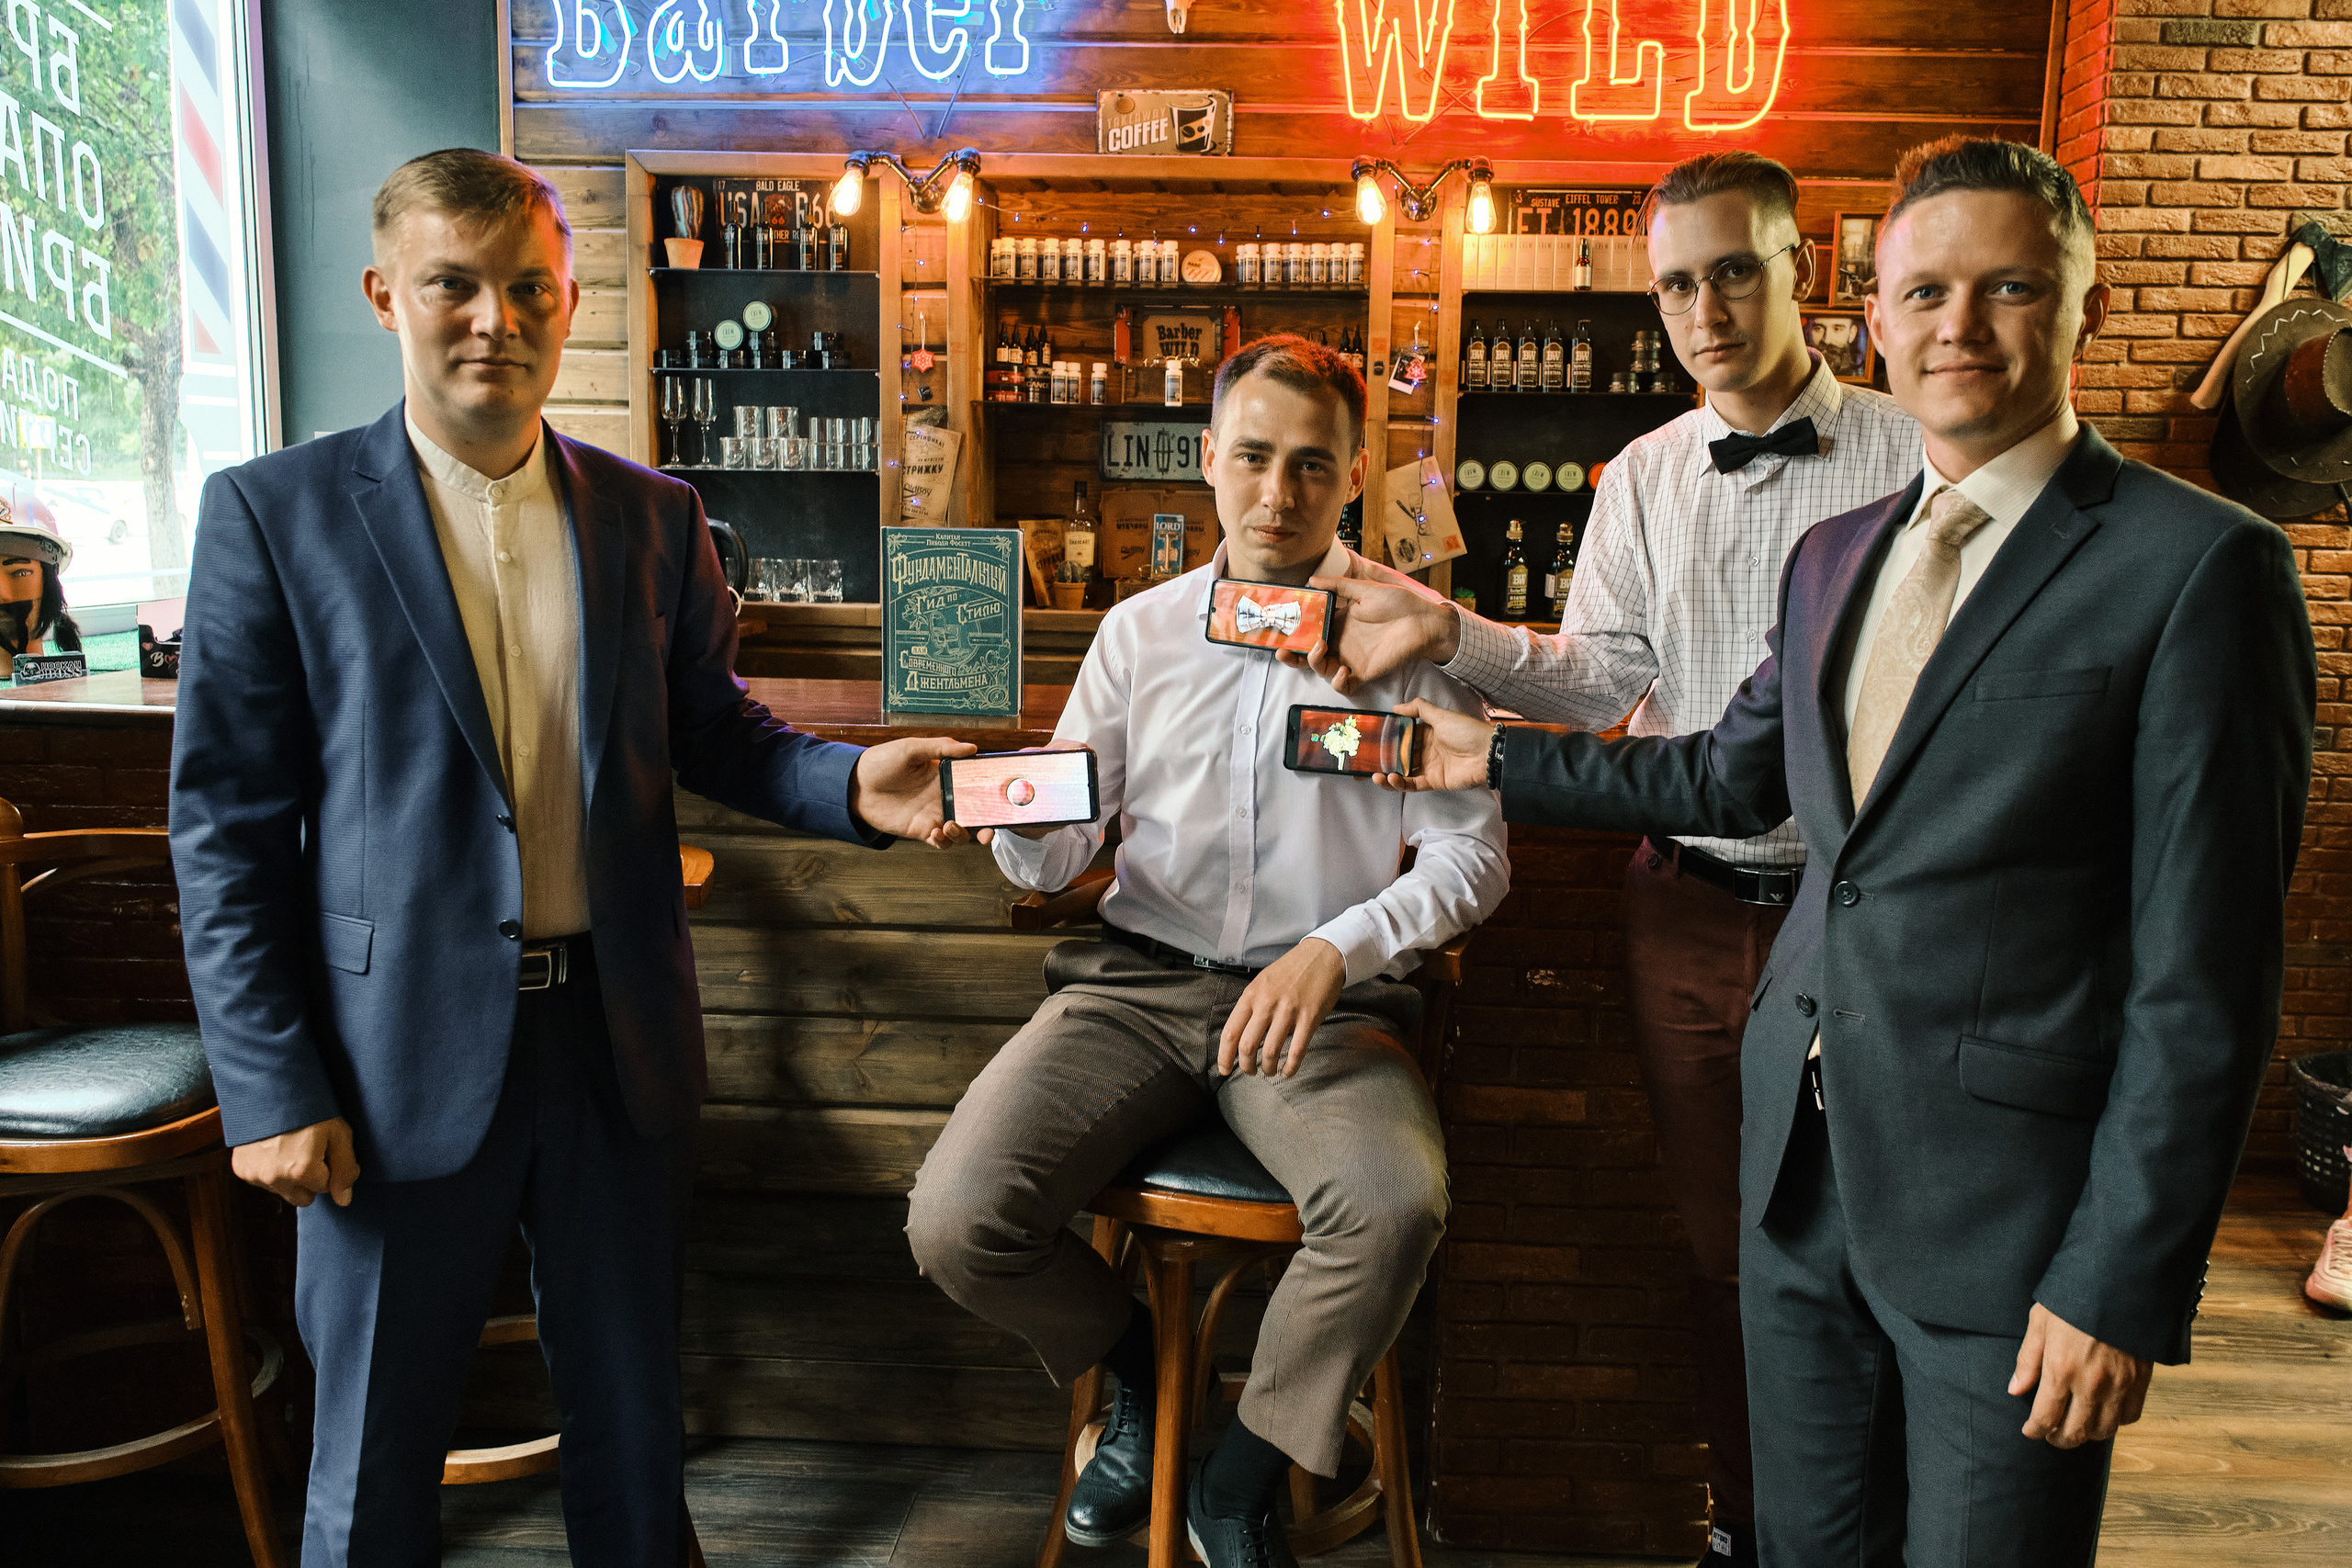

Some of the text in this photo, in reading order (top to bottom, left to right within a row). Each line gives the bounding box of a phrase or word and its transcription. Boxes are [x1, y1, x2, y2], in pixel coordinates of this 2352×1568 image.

[1335, 0, 1791, 131] WILD
[1108, 118, 1168, 152] COFFEE
[756, 181, 800, 192] BALD EAGLE
[1531, 197, 1561, 208] GUSTAVE
[1566, 194, 1619, 205] EIFFEL TOWER
[1156, 321, 1202, 341] Barber
[1159, 341, 1199, 358] WILD
[1470, 350, 1485, 360] BW
[1496, 350, 1510, 360] BW
[1521, 350, 1536, 361] BW
[1546, 350, 1561, 361] BW
[1576, 350, 1589, 361] BW
[1107, 434, 1149, 468] LIN
[1156, 522, 1182, 531] LORD
[1512, 573, 1527, 585] BW
